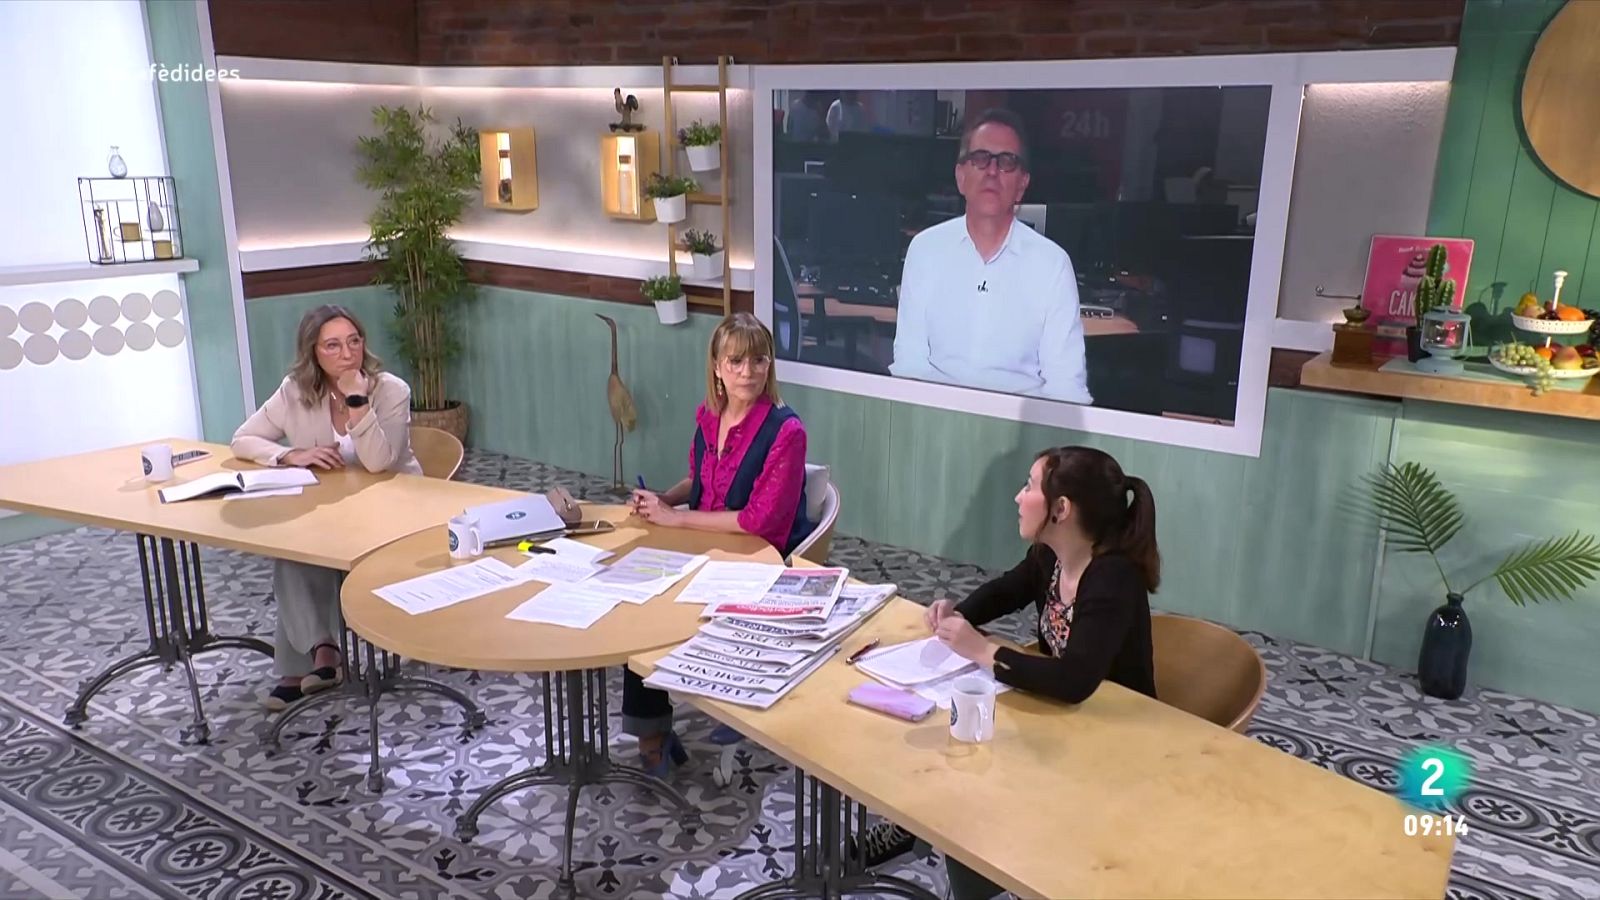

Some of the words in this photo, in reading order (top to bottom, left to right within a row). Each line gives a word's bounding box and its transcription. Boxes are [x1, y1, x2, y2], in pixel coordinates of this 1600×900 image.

[1061, 109, 1109, 138] 24h
[1388, 290, 1417, 317] CAK
[723, 645, 764, 658] ABC
